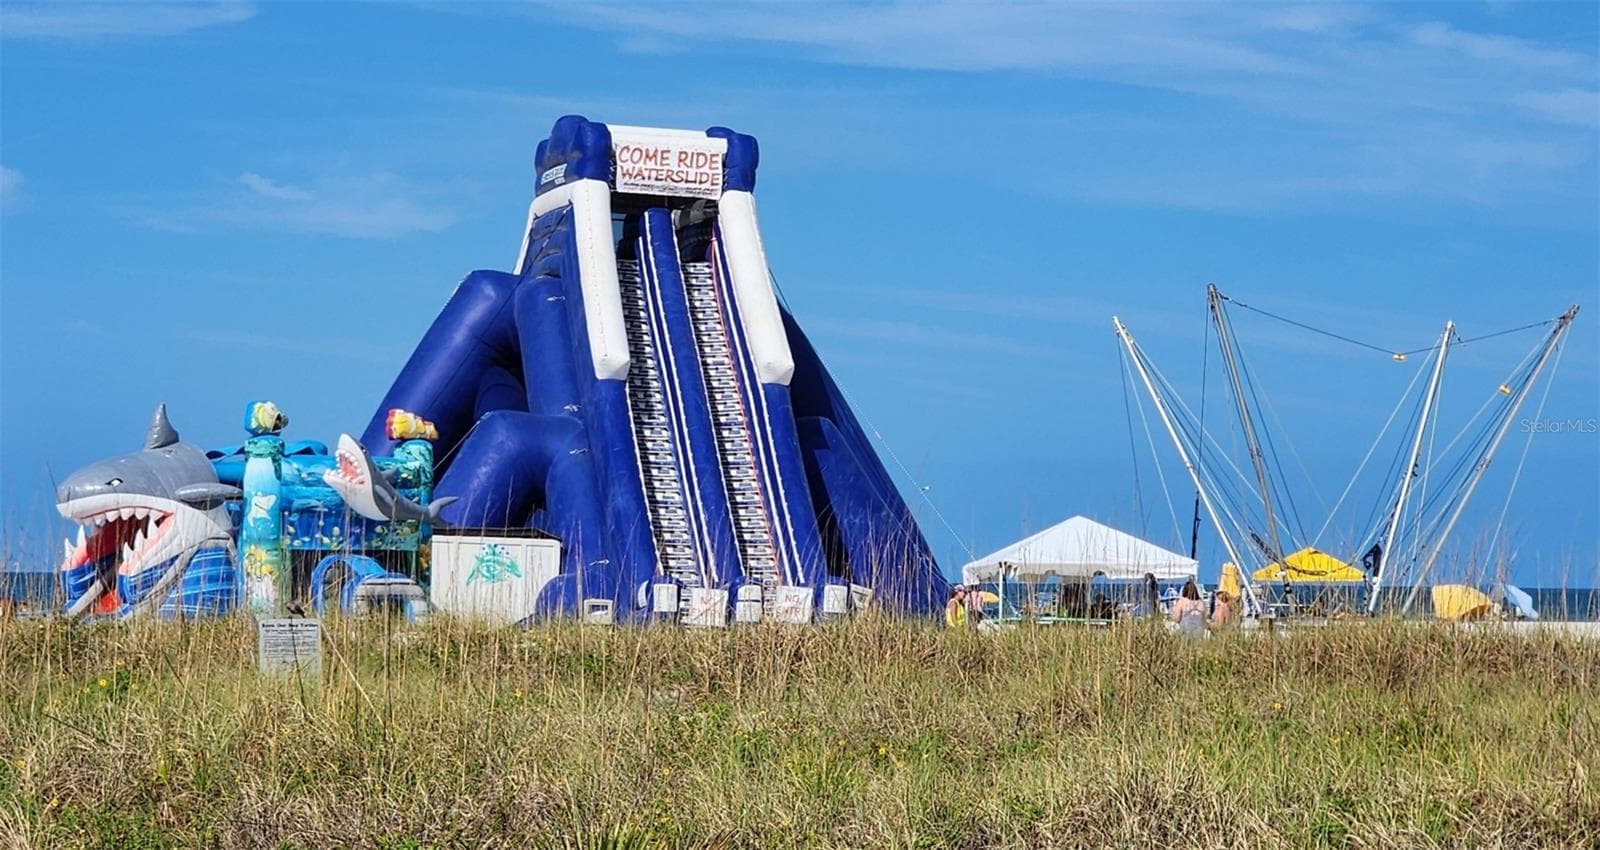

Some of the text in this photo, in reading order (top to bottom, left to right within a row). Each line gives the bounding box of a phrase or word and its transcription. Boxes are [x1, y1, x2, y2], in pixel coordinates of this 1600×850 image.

[618, 145, 720, 171] COME RIDE
[620, 166, 720, 186] WATERSLIDE
